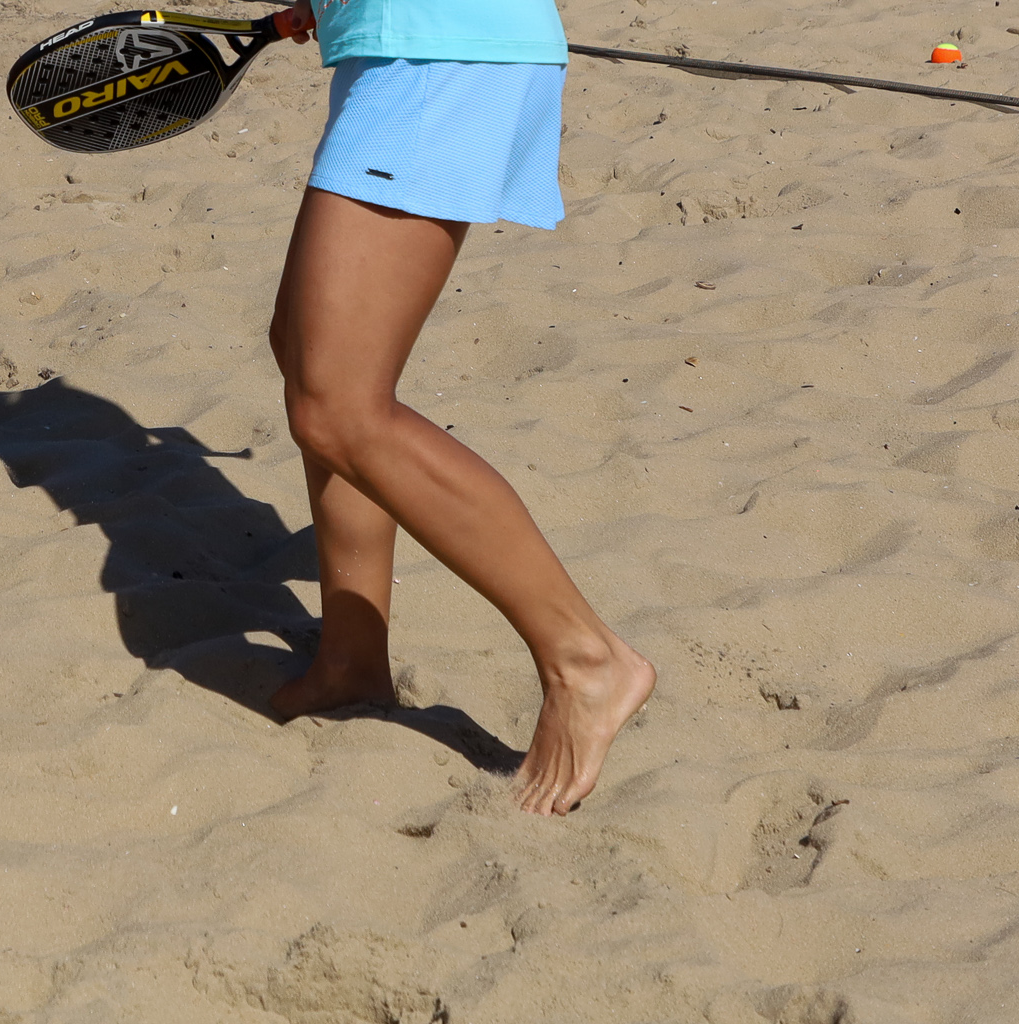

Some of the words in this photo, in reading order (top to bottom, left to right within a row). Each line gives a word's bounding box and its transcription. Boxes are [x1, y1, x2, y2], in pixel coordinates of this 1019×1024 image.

[40, 20, 95, 51] HEAD
[53, 60, 189, 118] VAIRO
[28, 107, 50, 127] PRO
